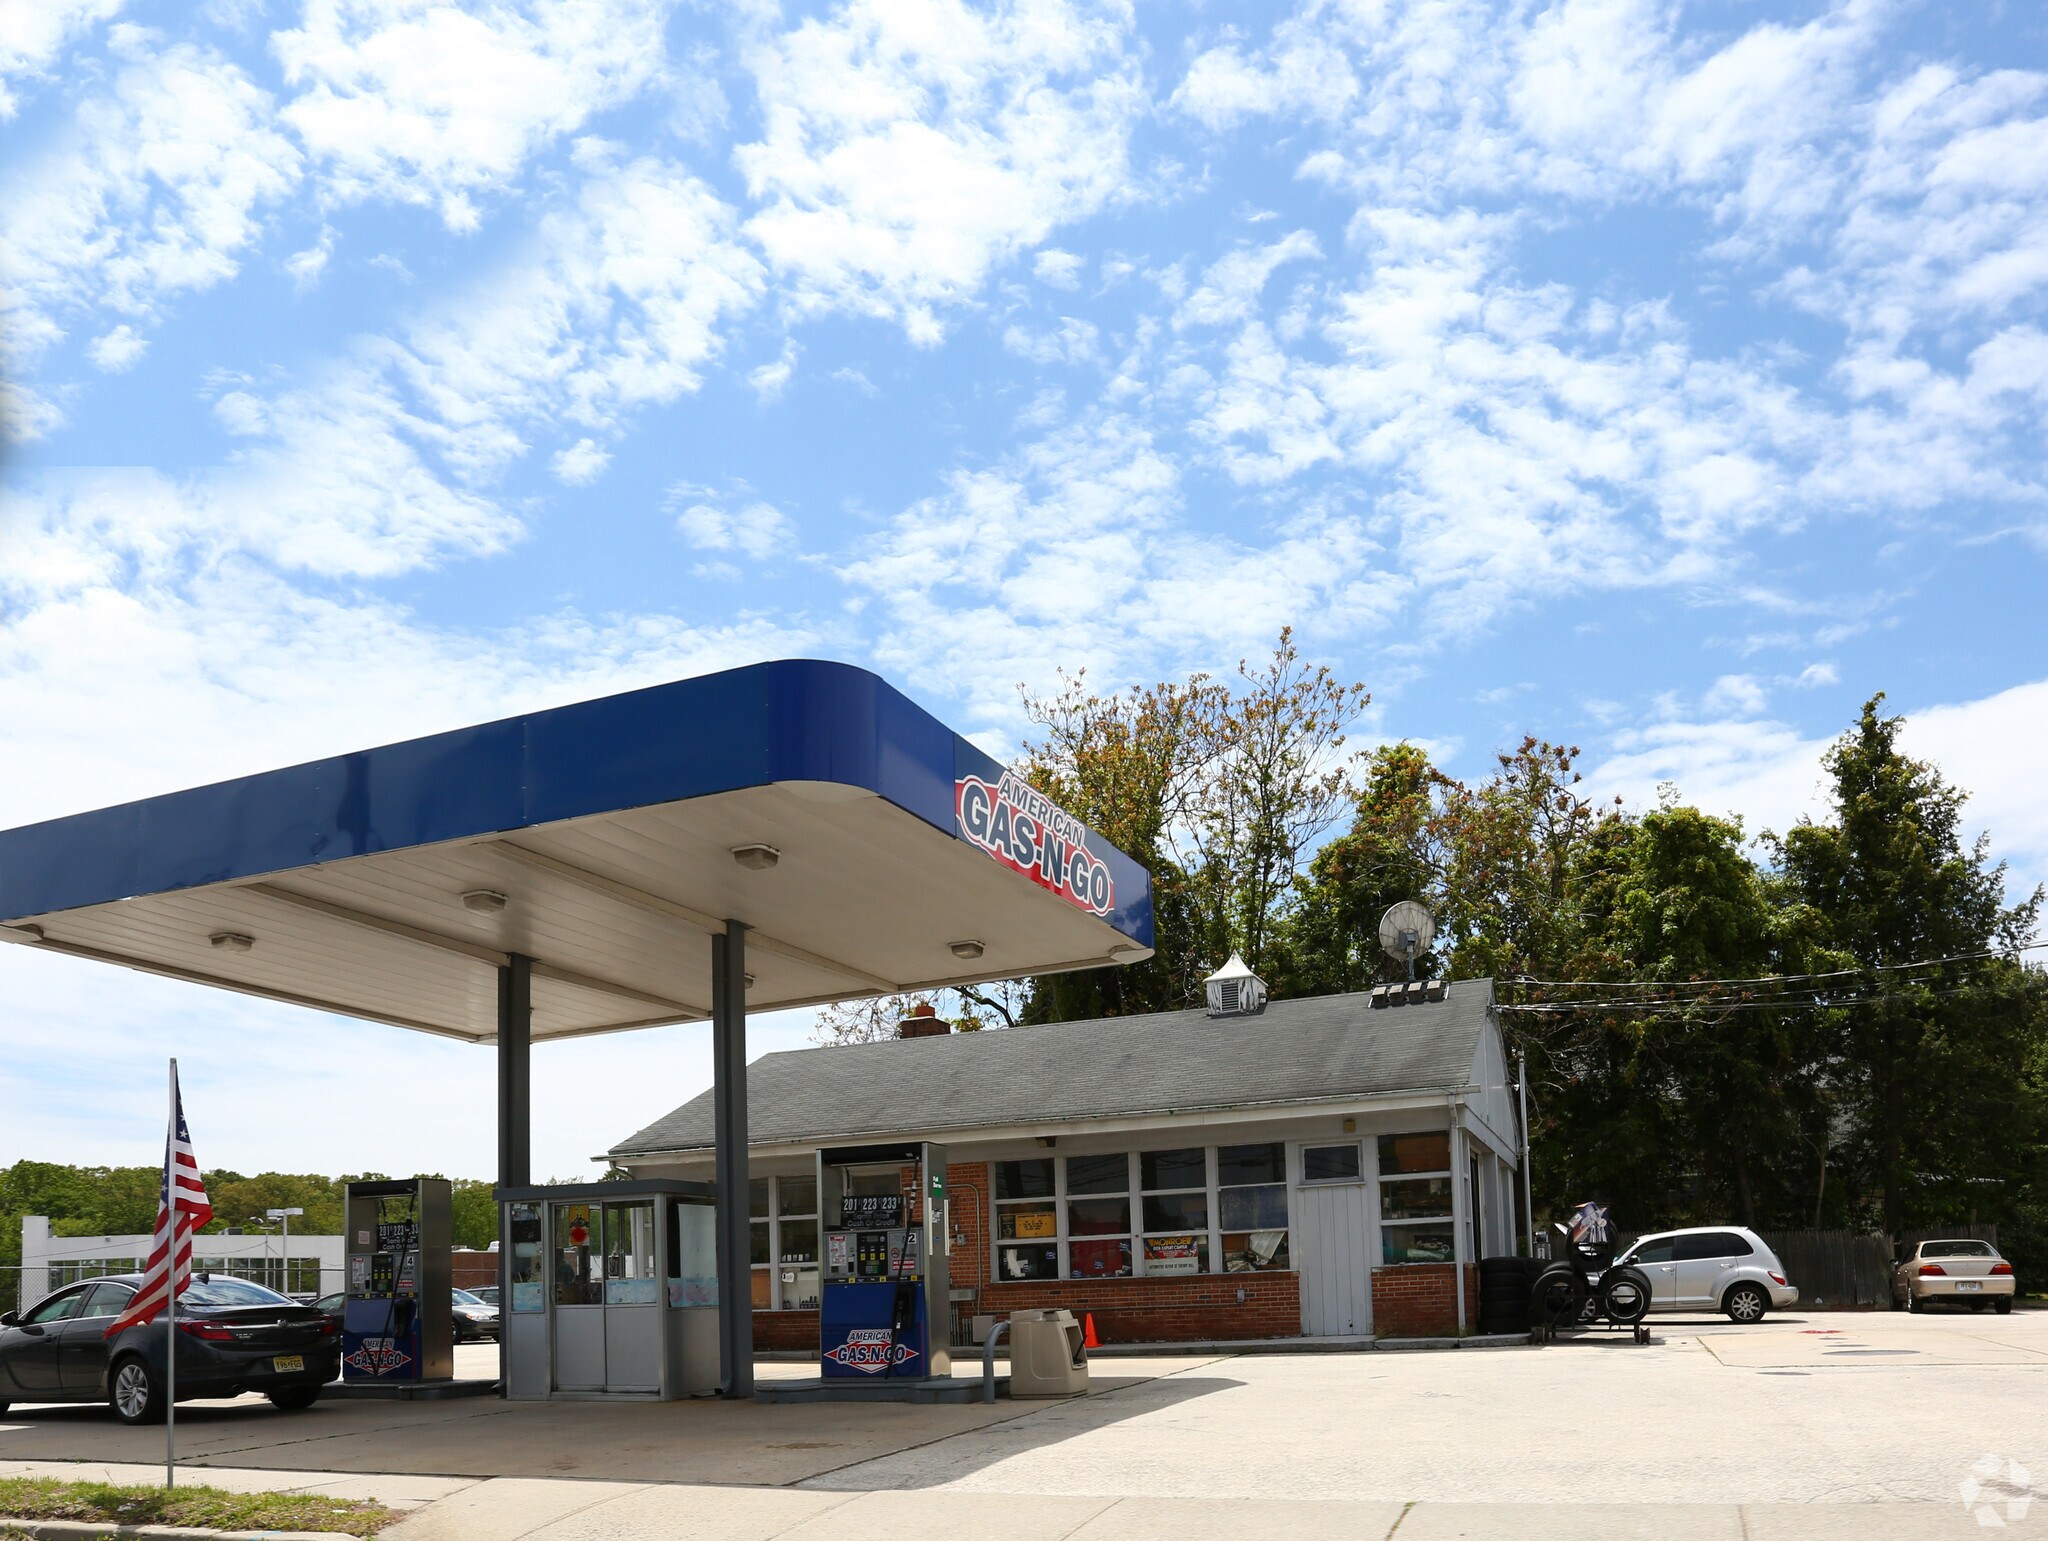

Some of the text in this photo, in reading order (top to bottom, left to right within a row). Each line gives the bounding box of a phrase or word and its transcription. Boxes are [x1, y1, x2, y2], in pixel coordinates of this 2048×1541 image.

[999, 774, 1084, 850] AMERICAN
[844, 1197, 897, 1211] 201 223 233
[407, 1257, 413, 1265] 4
